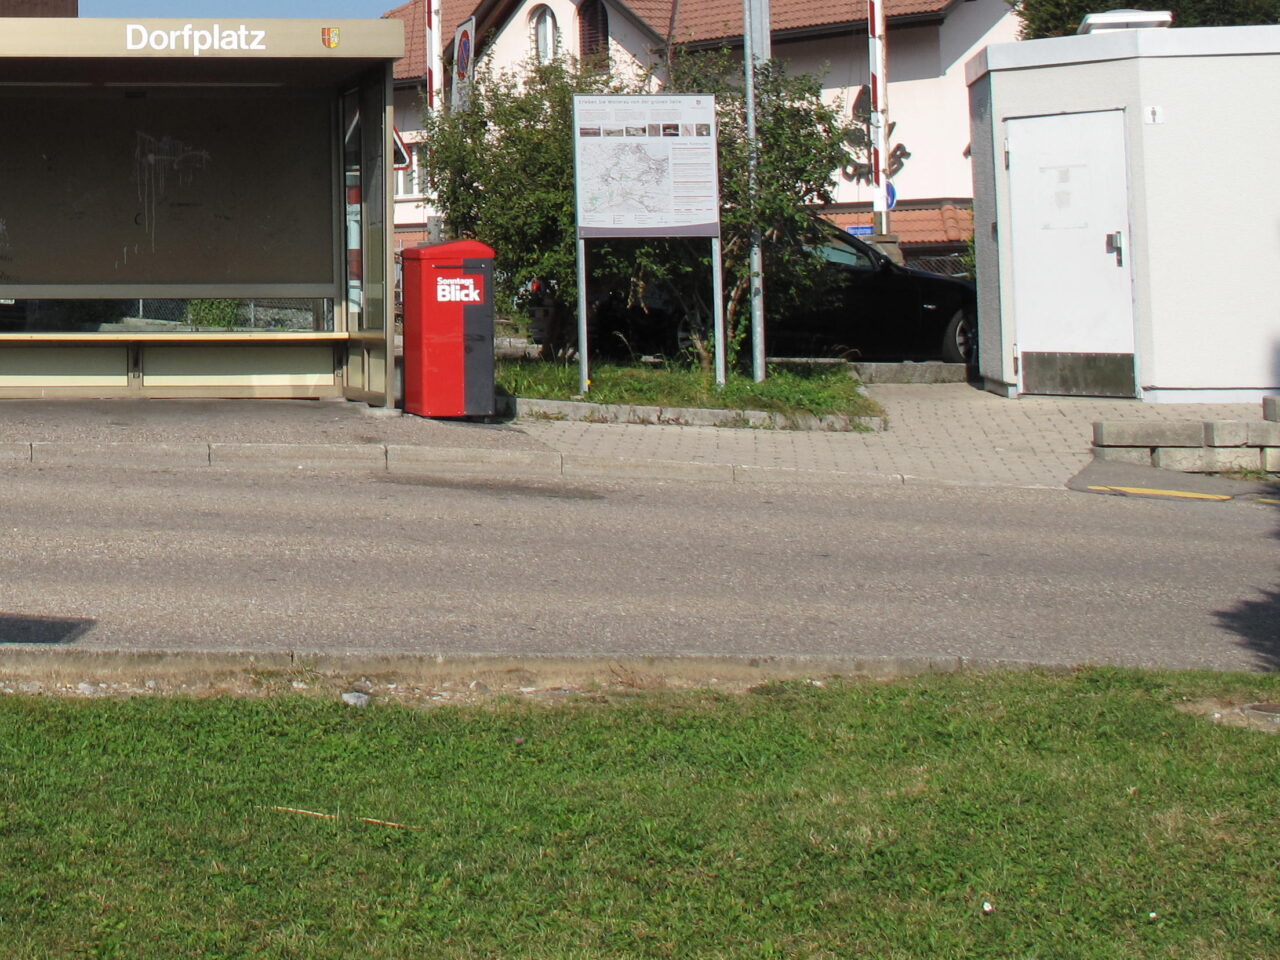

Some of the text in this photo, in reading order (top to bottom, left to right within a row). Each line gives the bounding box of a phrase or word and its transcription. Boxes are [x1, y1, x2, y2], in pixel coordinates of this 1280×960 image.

[126, 24, 266, 56] Dorfplatz
[437, 277, 474, 286] Sonntags
[437, 284, 480, 302] Blick
